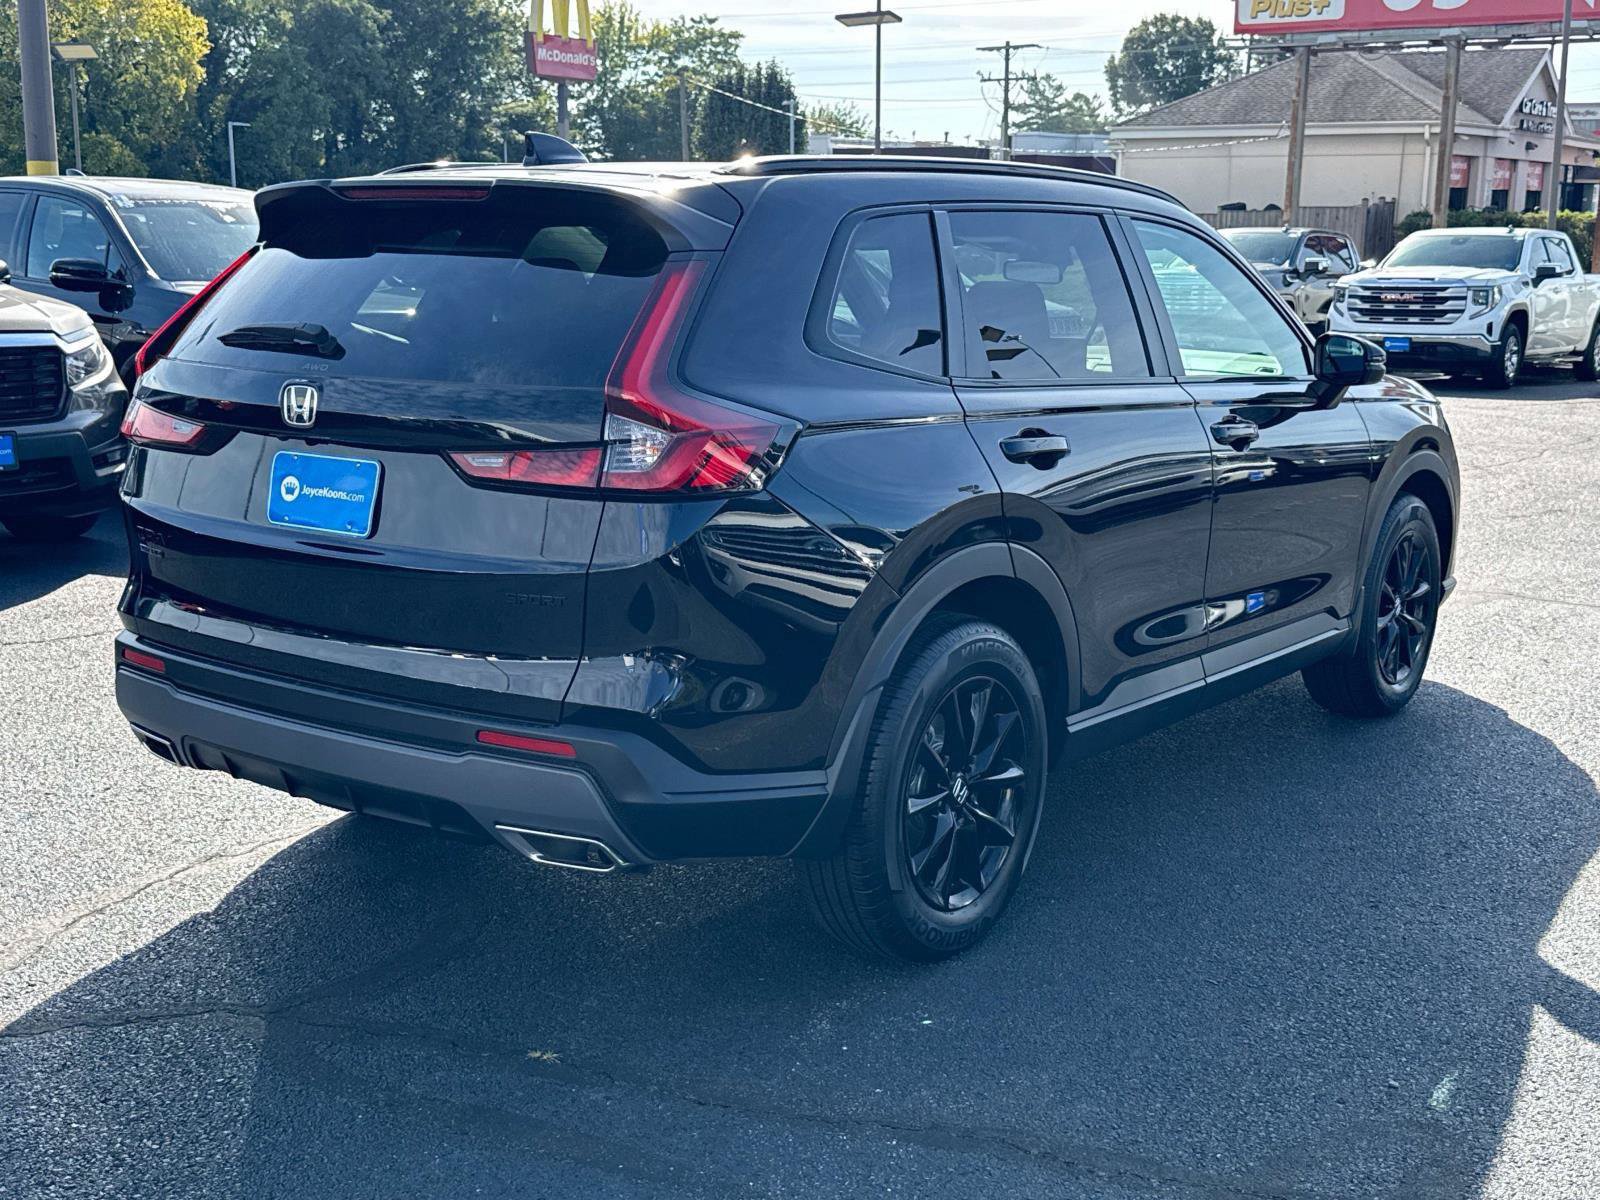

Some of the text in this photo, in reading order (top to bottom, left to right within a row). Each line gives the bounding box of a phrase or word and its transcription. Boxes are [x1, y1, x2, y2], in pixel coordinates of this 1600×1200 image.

[537, 47, 596, 66] McDonald's
[303, 362, 329, 372] AWD
[301, 484, 365, 503] JoyceKoons.com
